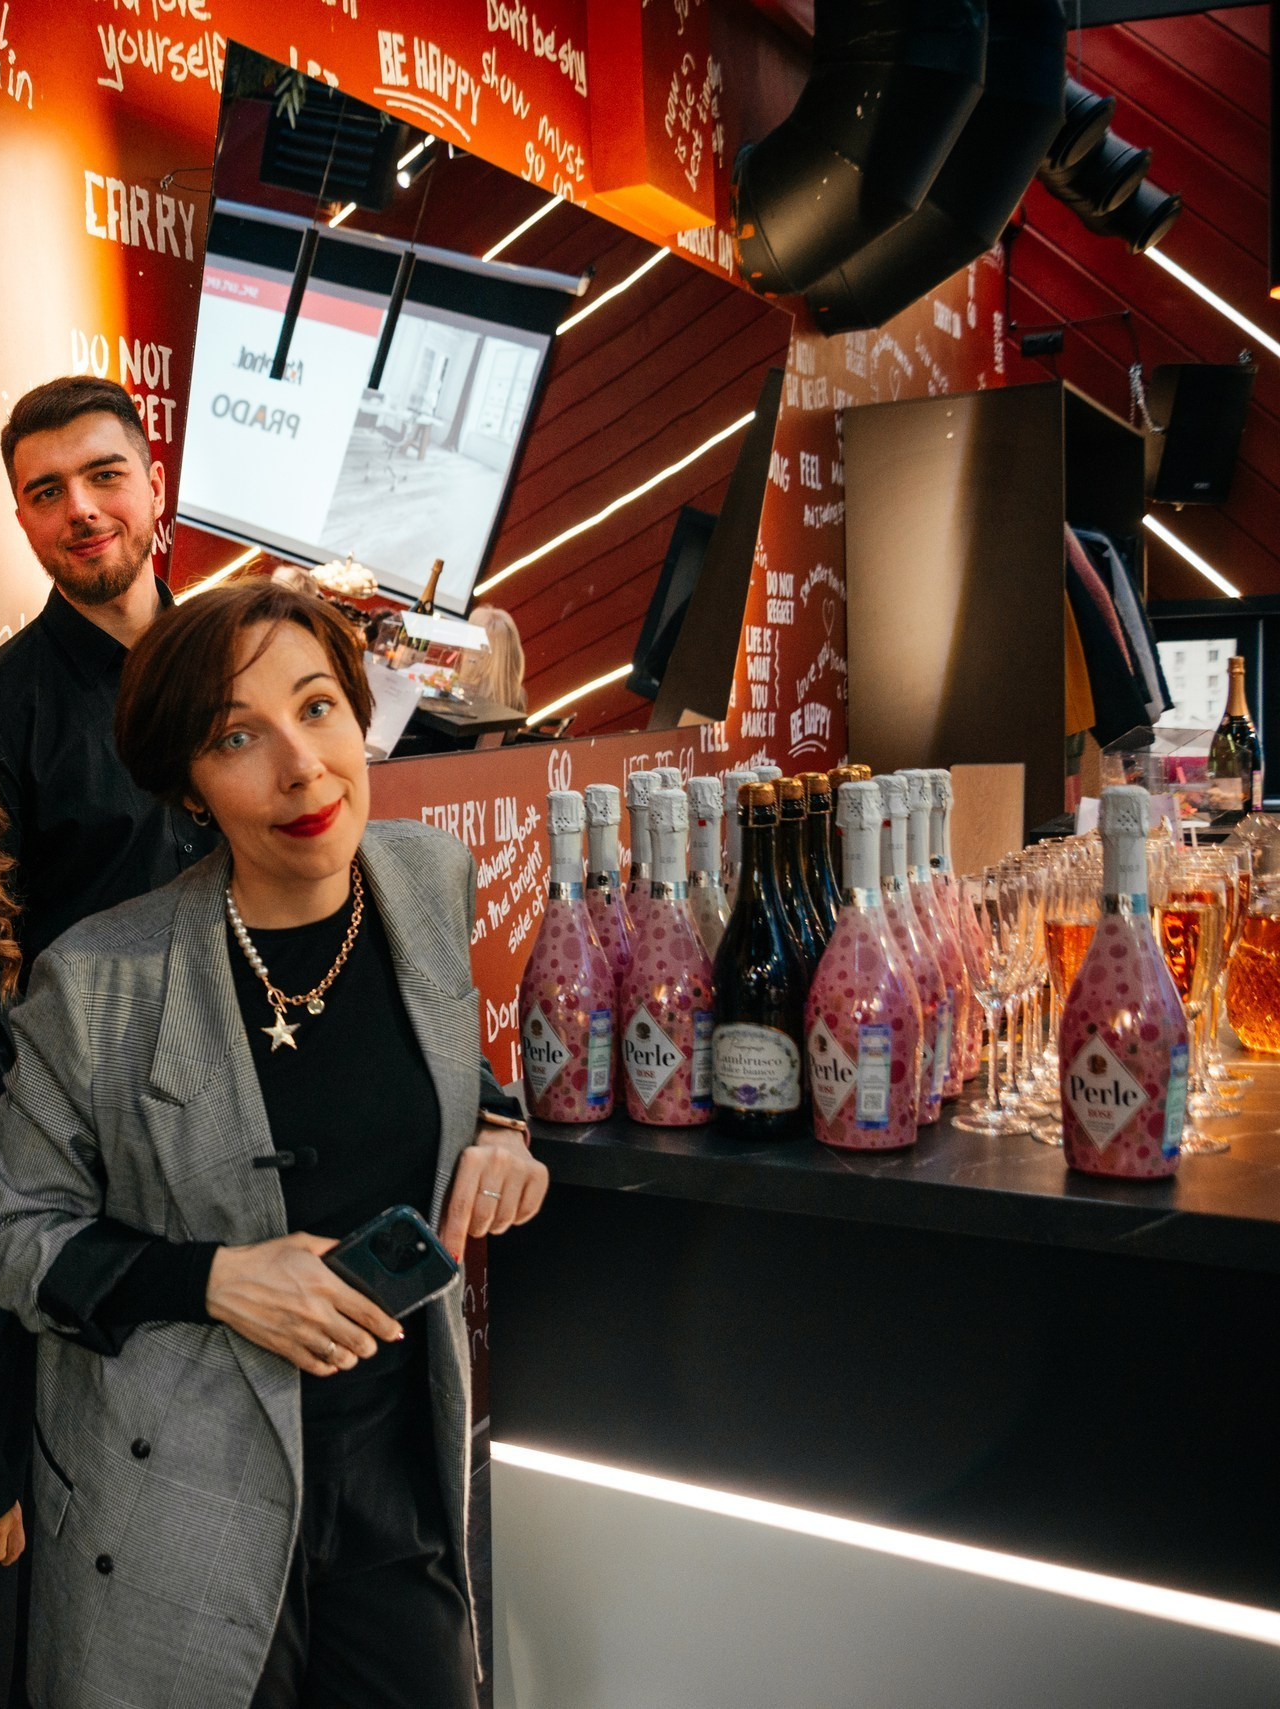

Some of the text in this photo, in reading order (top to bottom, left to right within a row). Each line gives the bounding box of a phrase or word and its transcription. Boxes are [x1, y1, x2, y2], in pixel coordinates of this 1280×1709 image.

[532, 13, 557, 62] be
[558, 38, 587, 98] shy
[377, 30, 409, 86] BE
[414, 36, 481, 126] HAPPY
[538, 115, 584, 182] must
[84, 170, 195, 262] CARRY
[70, 329, 109, 379] DO
[119, 336, 172, 391] NOT
[800, 452, 822, 491] FEEL
[766, 571, 795, 599] DO NOT
[767, 599, 795, 626] REGRET
[746, 625, 772, 655] LIFE IS
[746, 655, 771, 683] WHAT
[750, 684, 768, 710] YOU
[741, 711, 776, 738] MAKE IT
[790, 701, 832, 746] BE HAPPY
[548, 749, 572, 791] GO
[494, 796, 518, 842] ON
[471, 841, 542, 945] on the bright
[508, 908, 533, 954] side
[532, 885, 545, 917] of
[523, 1037, 563, 1065] Perle
[625, 1039, 676, 1067] Perle
[1071, 1075, 1137, 1106] Perle
